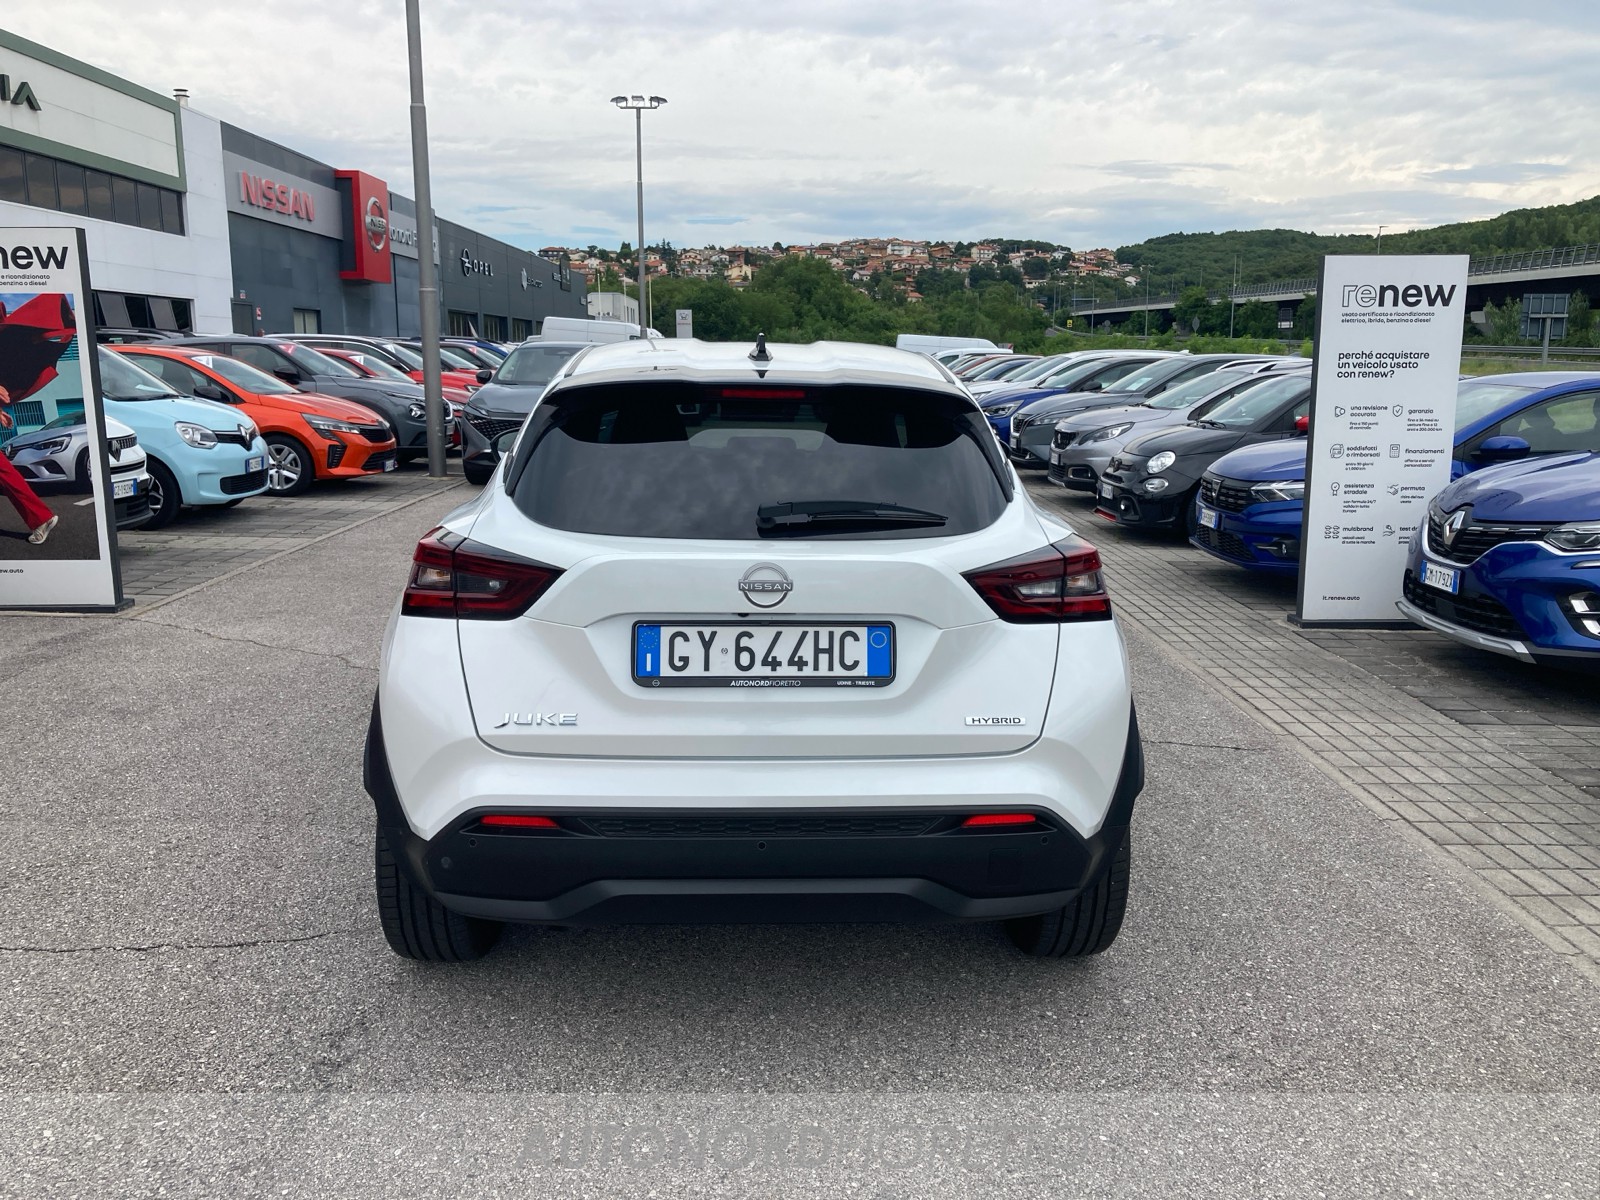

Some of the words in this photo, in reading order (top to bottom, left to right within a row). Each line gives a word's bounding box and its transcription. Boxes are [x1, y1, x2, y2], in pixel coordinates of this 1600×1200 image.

[241, 171, 315, 221] NISSAN
[474, 259, 494, 277] OPEL
[1342, 284, 1457, 308] renew
[1338, 351, 1373, 361] perché
[1375, 351, 1430, 361] acquistare
[1337, 361, 1350, 369] un
[1352, 360, 1388, 369] veicolo
[1390, 361, 1419, 369] usato
[1337, 370, 1356, 378] con
[1357, 370, 1395, 378] renew?
[740, 582, 792, 590] NISSAN
[668, 630, 718, 672] GY
[734, 630, 861, 672] 644HC
[494, 713, 578, 728] JUKE
